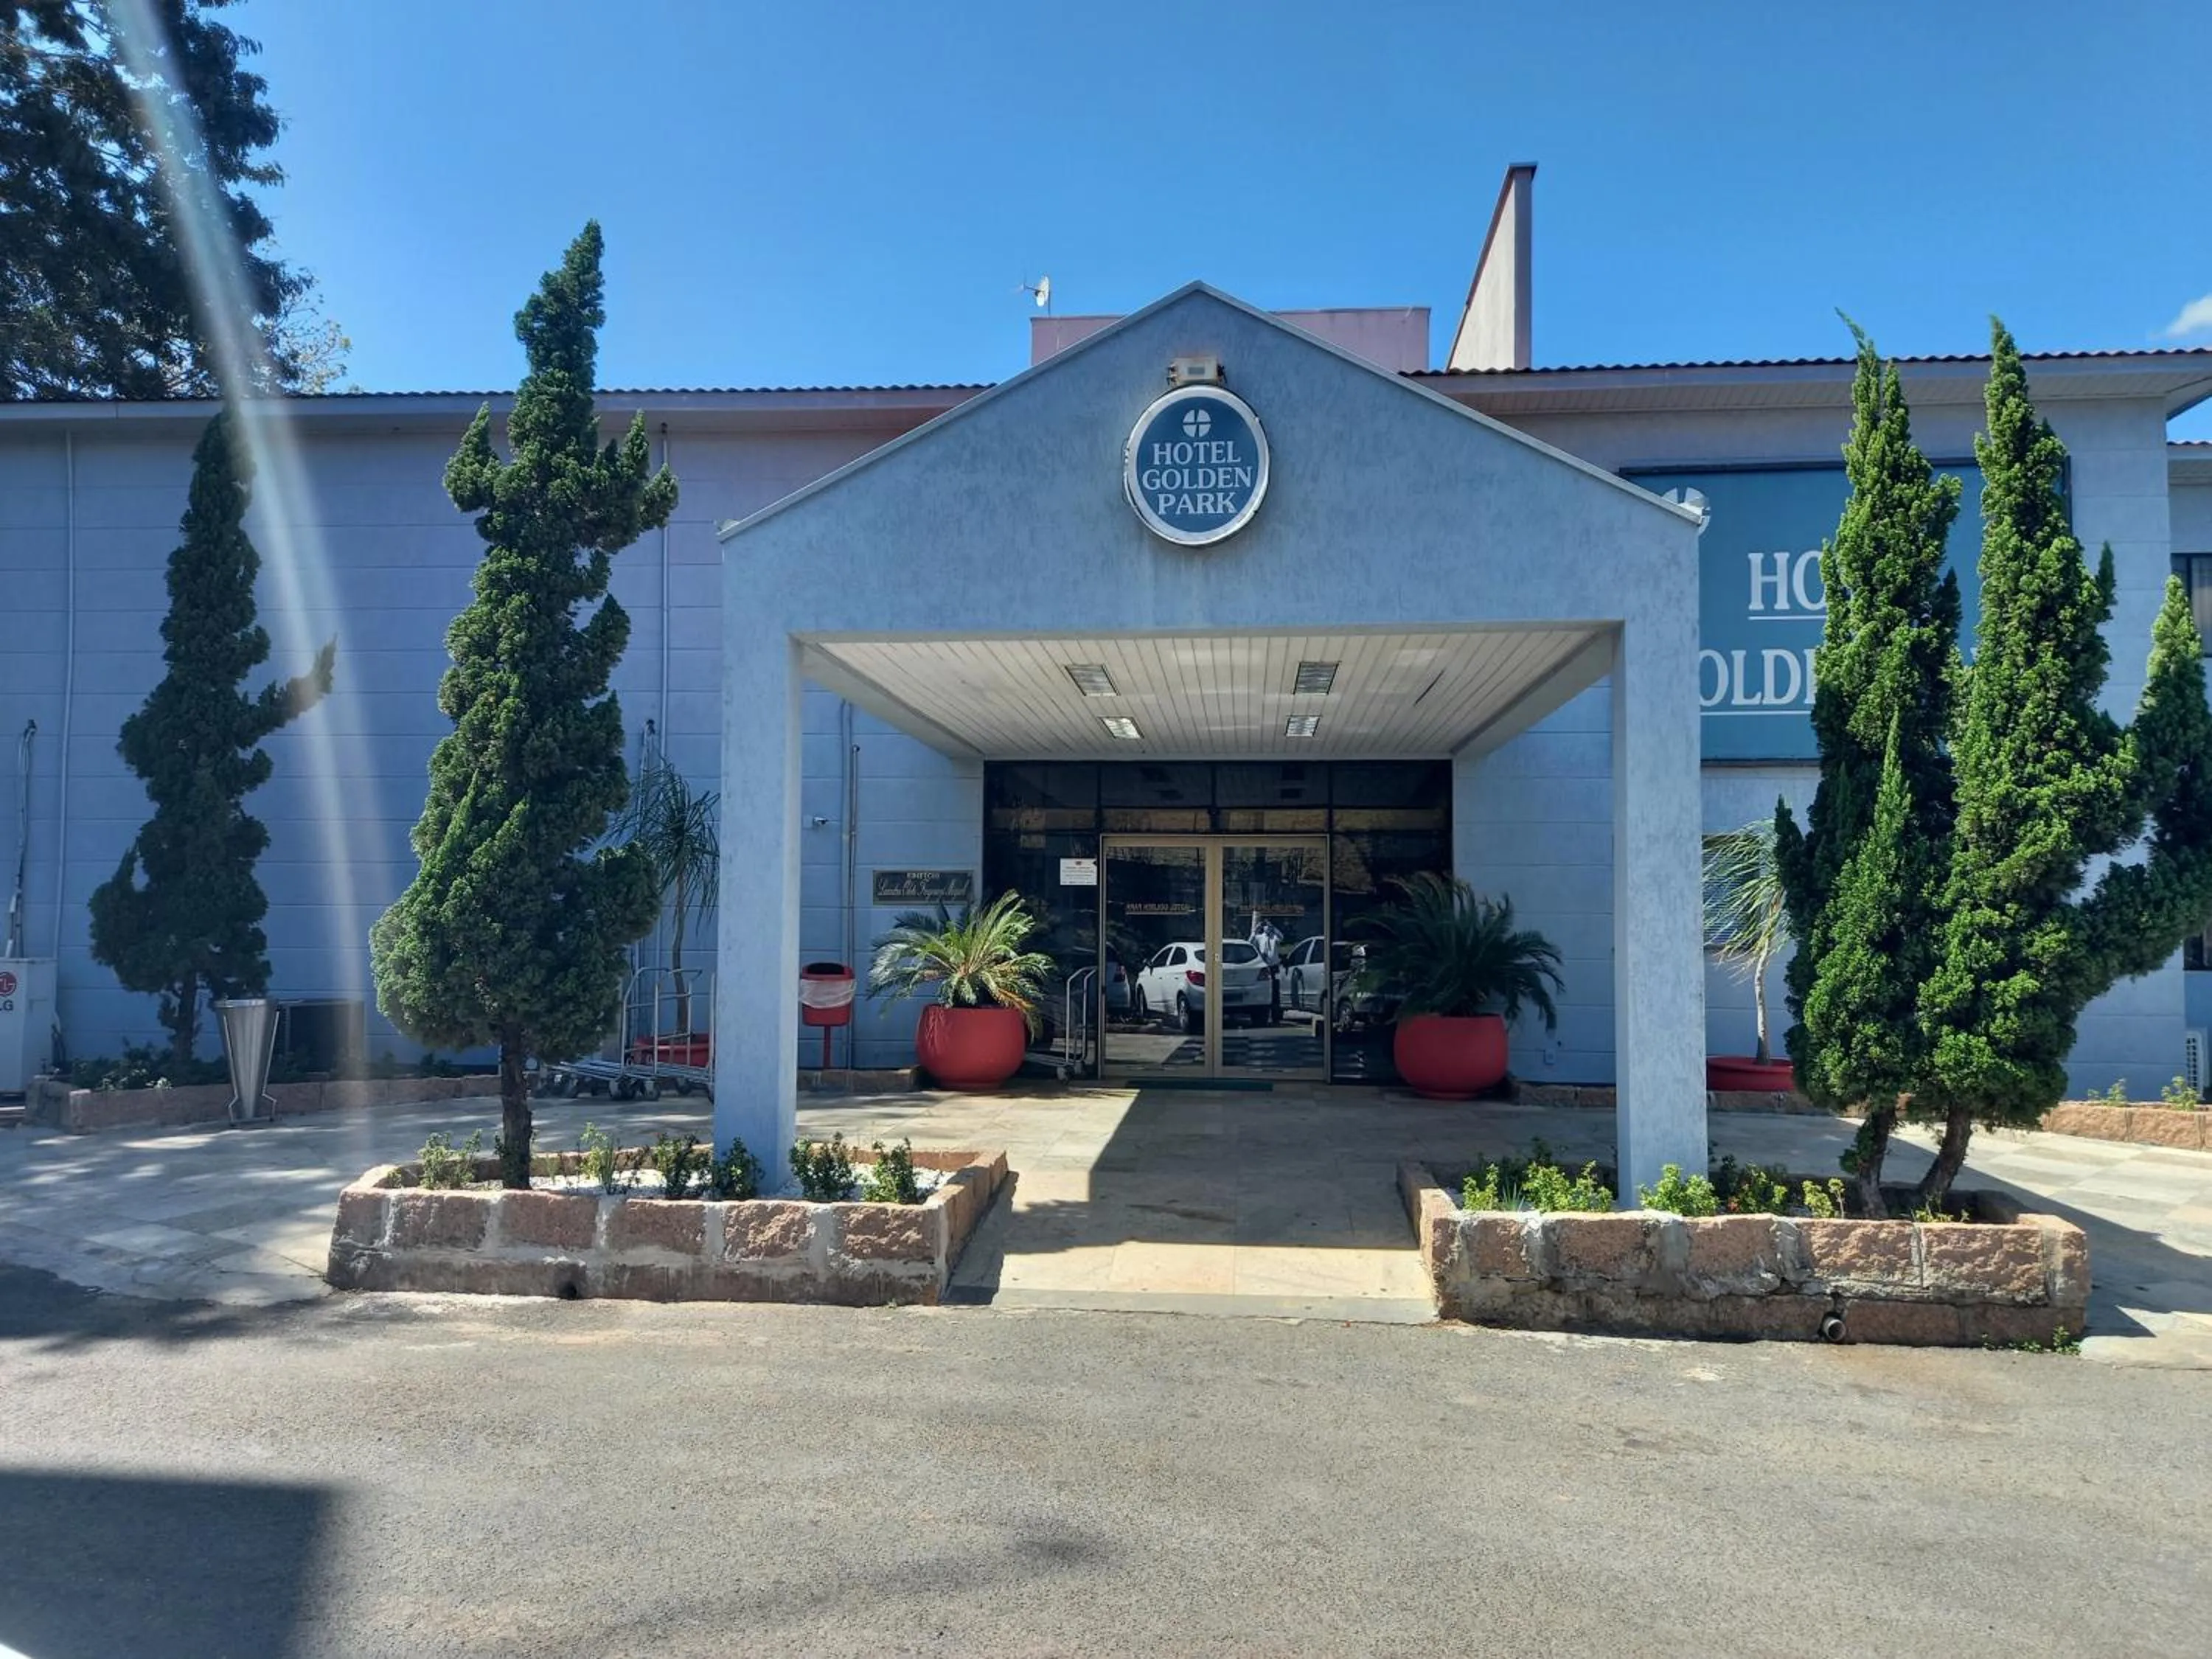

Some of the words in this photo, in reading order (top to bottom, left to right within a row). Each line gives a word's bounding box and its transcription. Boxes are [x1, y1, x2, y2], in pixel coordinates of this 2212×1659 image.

[1152, 441, 1242, 465] HOTEL
[1142, 466, 1253, 490] GOLDEN
[1158, 492, 1239, 515] PARK
